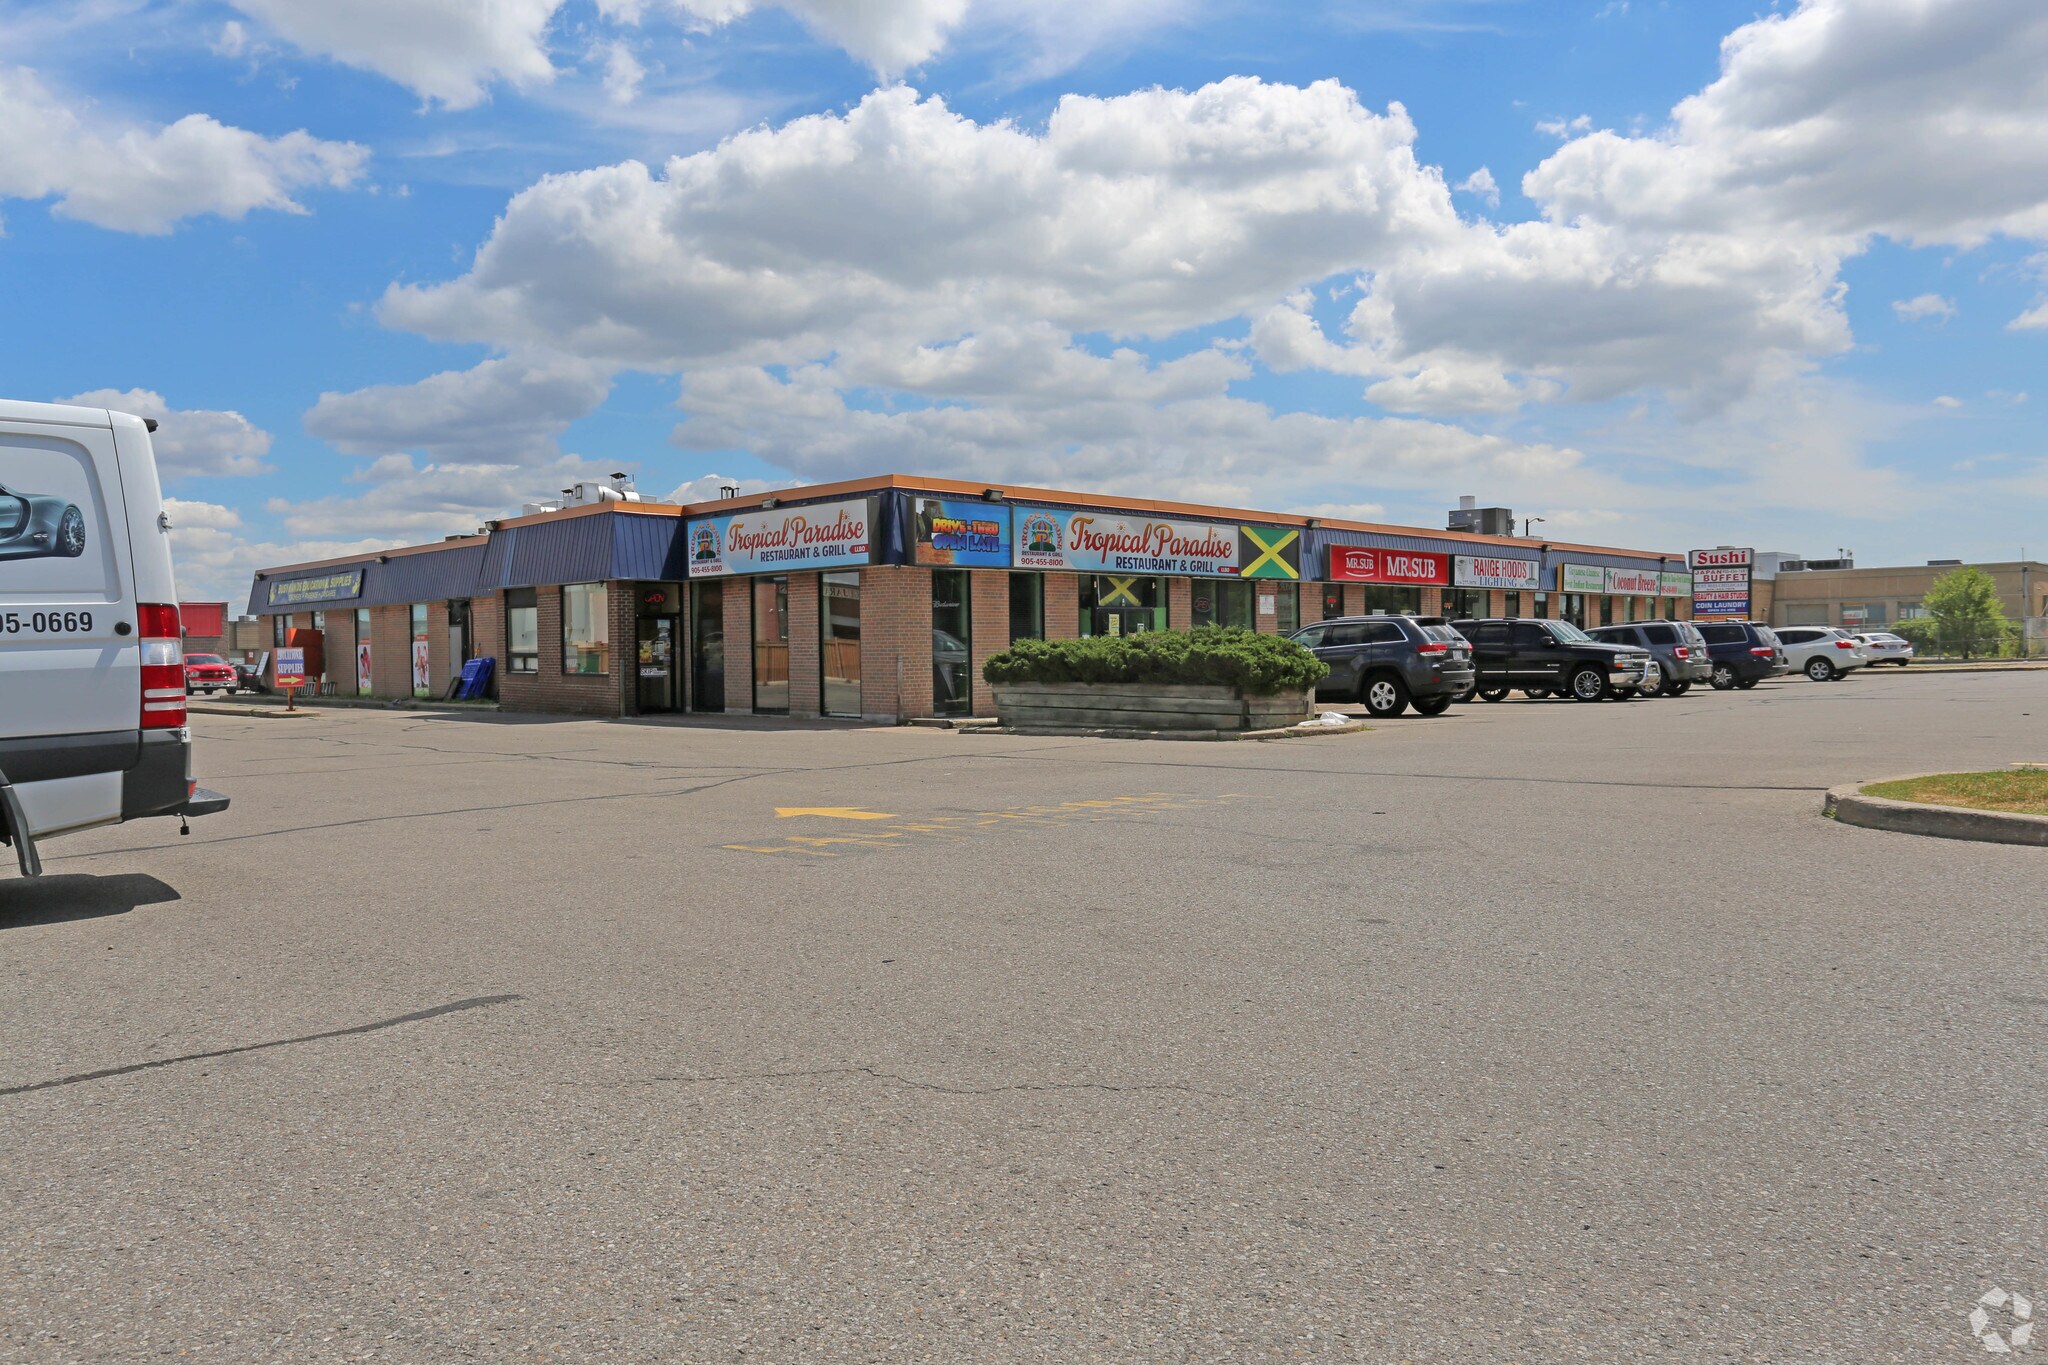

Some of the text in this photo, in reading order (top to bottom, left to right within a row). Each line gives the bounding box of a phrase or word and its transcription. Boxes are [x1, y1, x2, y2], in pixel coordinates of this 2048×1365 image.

[729, 509, 864, 560] Tropical Paradise
[933, 518, 999, 536] DRIVE-THRU
[932, 534, 999, 552] OPEN LATE
[1070, 517, 1233, 564] Tropical Paradise
[760, 544, 846, 562] RESTAURANT & GRILL
[1021, 557, 1063, 566] 905-455-8100
[1697, 551, 1746, 565] Sushi
[1115, 556, 1214, 573] RESTAURANT & GRILL
[1345, 557, 1374, 570] MR.SUB
[1386, 556, 1436, 578] MR.SUB
[1473, 559, 1527, 579] RANGE HOODS
[1479, 577, 1517, 587] LIGHTING
[1613, 572, 1637, 591] Coconut
[1638, 574, 1656, 592] Breeze
[1703, 574, 1746, 582] BUFFET
[1694, 592, 1712, 600] BEAUTY
[0, 612, 93, 633] 5-0669
[277, 662, 304, 674] SUPPLIES
